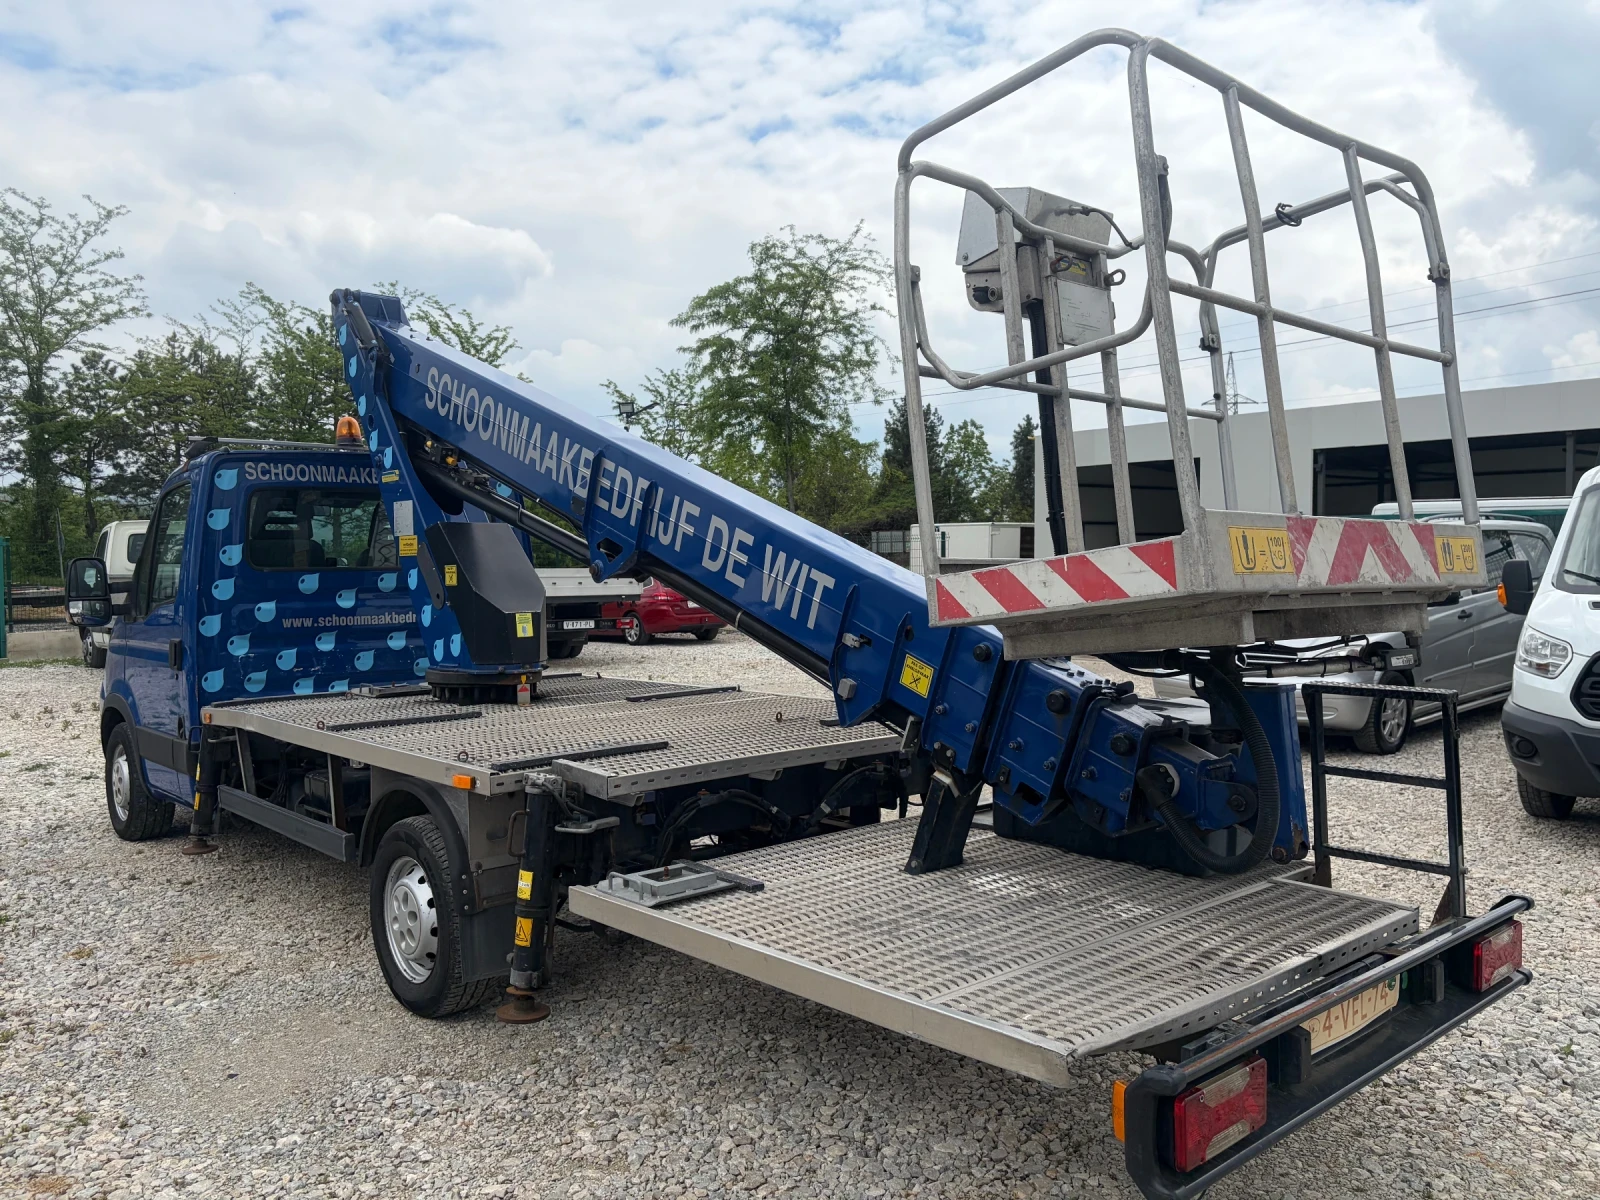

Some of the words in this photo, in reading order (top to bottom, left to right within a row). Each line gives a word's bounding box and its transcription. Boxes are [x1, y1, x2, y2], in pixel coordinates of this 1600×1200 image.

[1270, 536, 1282, 547] 100
[1273, 550, 1284, 560] KG
[701, 514, 755, 589] DE
[761, 543, 836, 630] WIT
[1322, 981, 1389, 1038] 4-VFL-74
